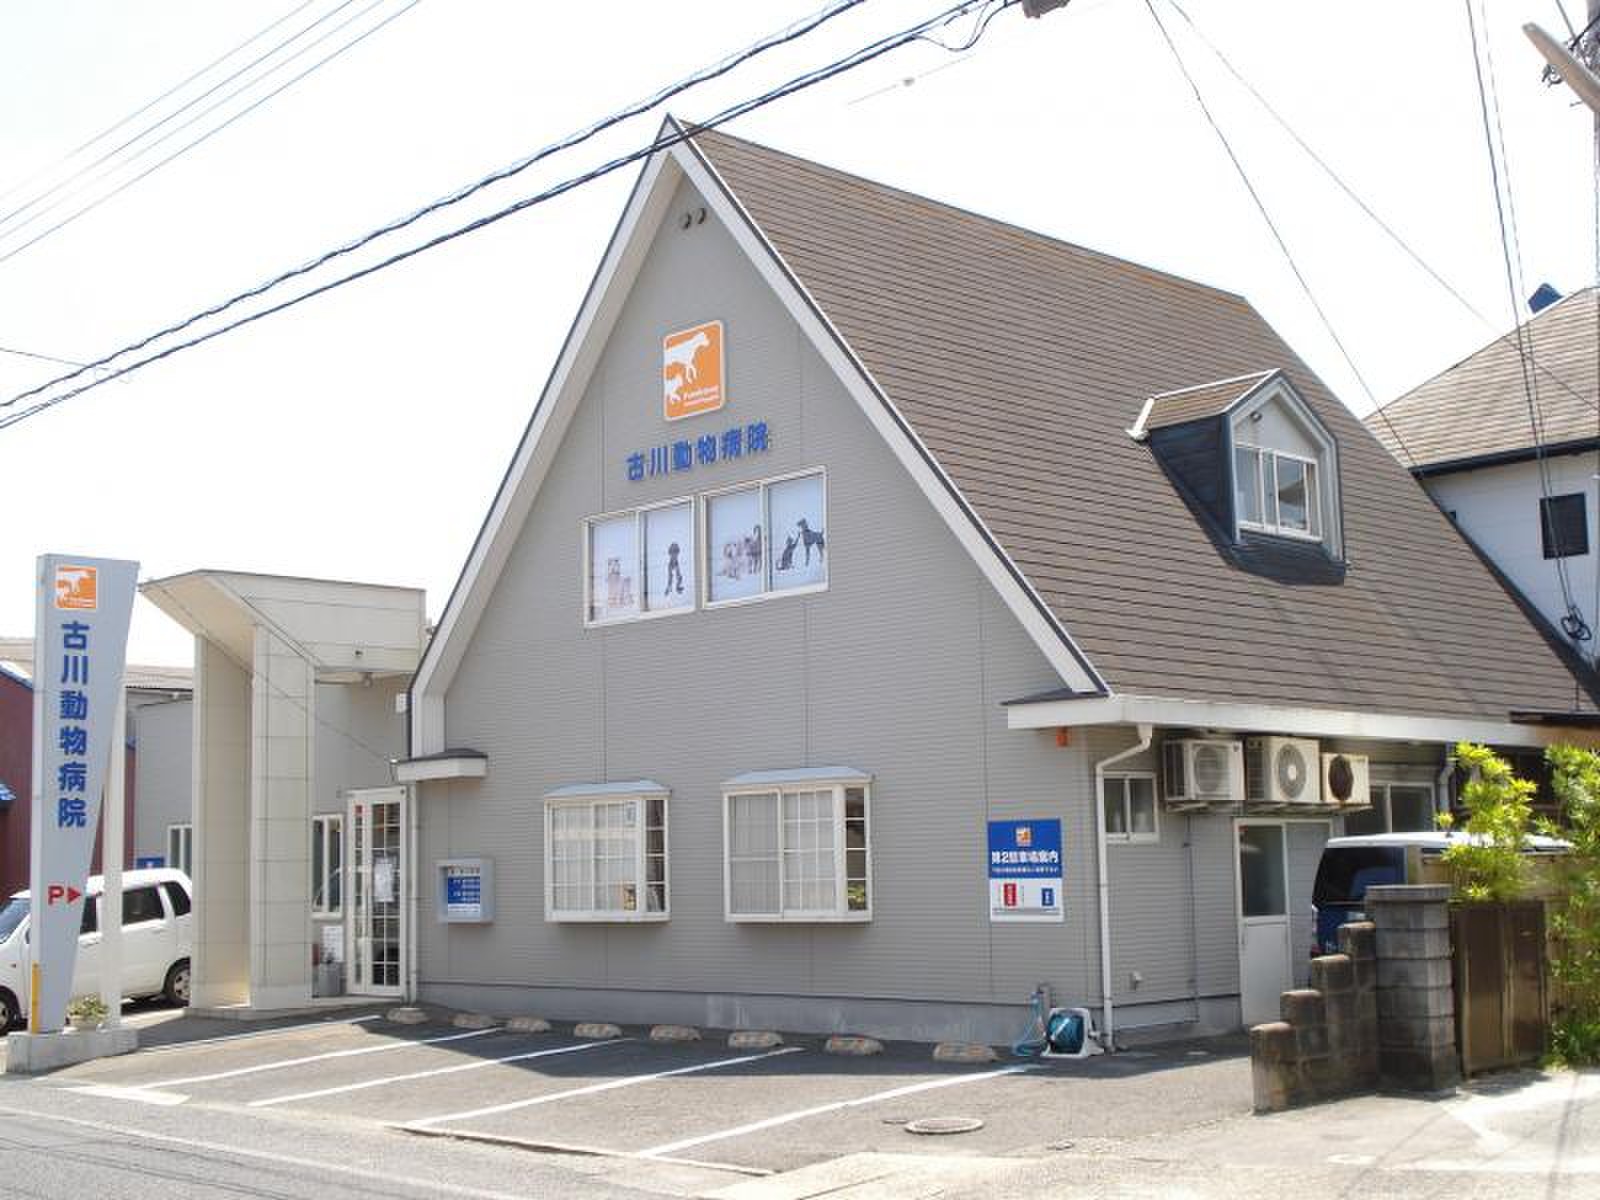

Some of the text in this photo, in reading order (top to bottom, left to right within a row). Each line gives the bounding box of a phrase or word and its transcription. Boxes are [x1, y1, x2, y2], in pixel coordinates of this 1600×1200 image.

[626, 420, 770, 481] 古川動物病院
[57, 620, 90, 829] 古川動物病院
[48, 884, 65, 906] P
